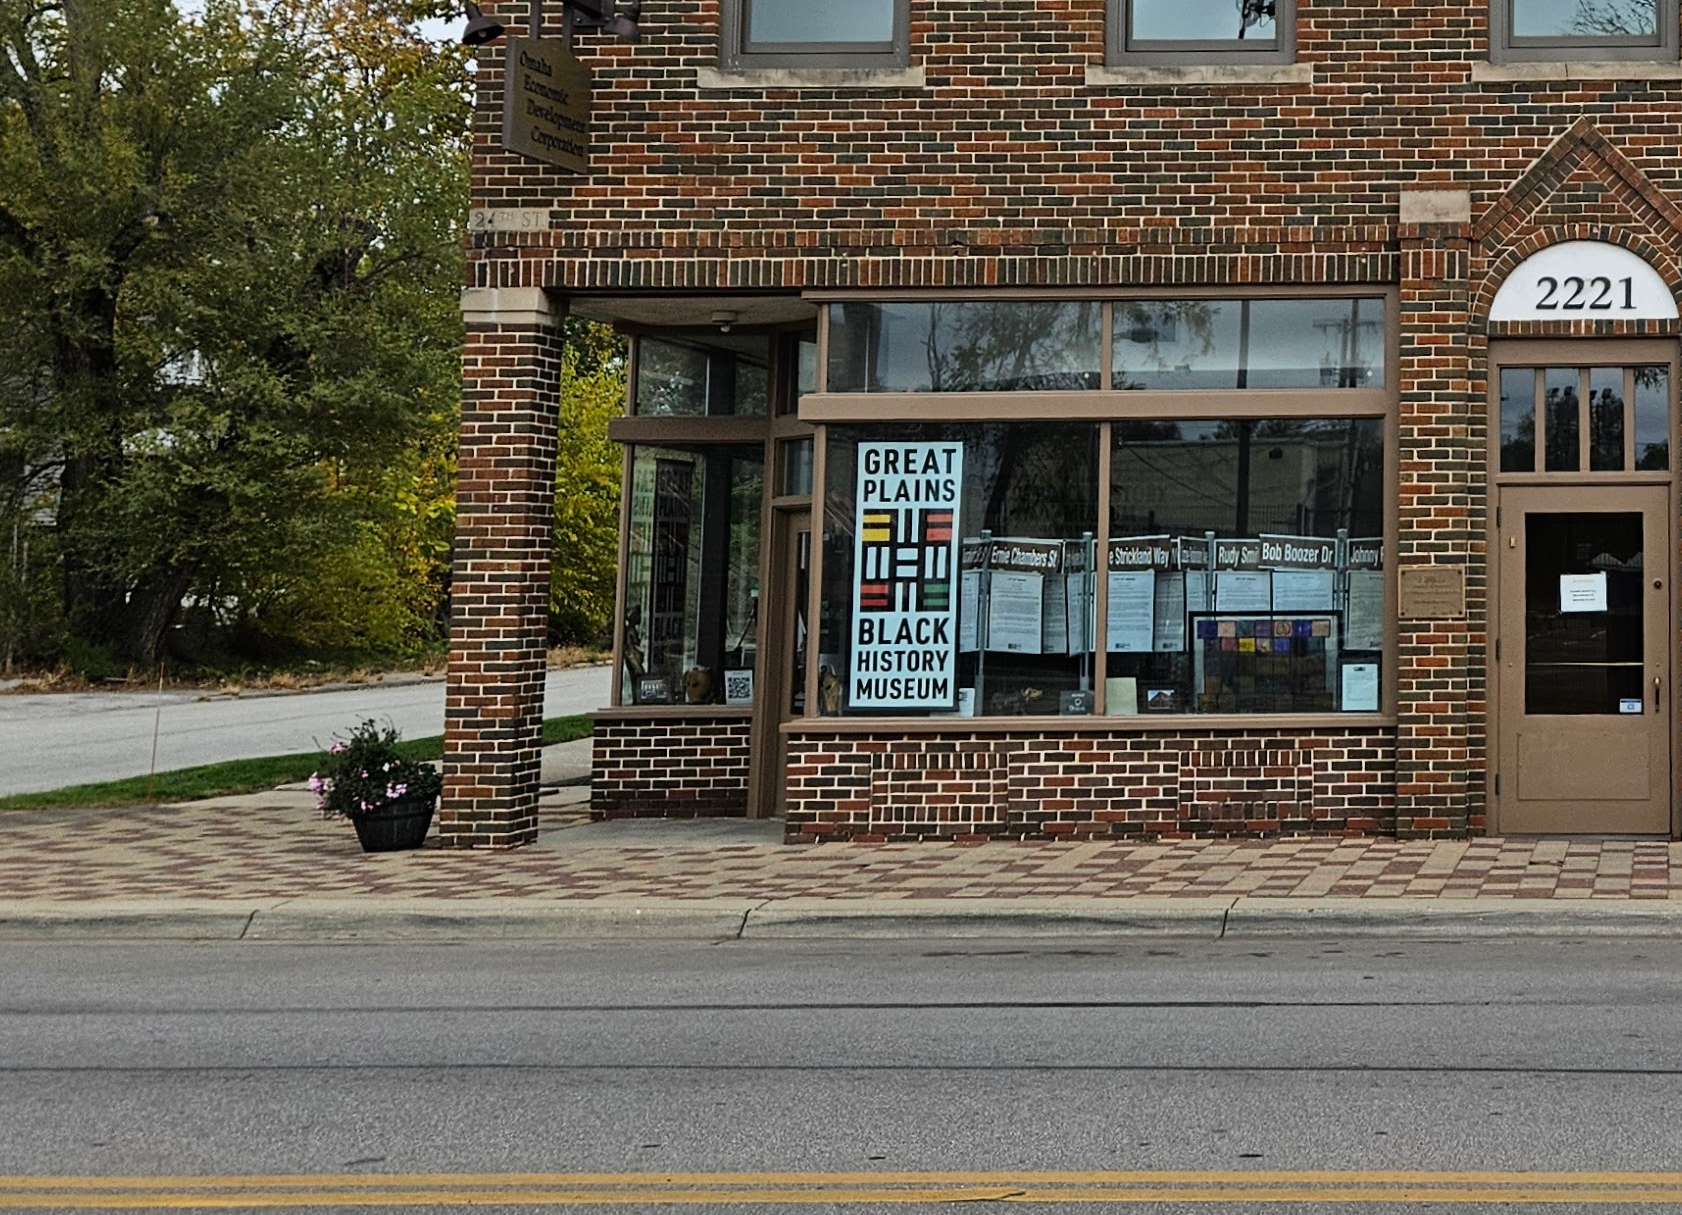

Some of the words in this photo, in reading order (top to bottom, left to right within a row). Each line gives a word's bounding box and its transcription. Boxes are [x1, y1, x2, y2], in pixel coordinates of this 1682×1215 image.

[520, 50, 552, 77] Omaha
[524, 73, 570, 105] Economic
[526, 97, 586, 134] Development
[530, 126, 584, 157] Corporation
[1535, 276, 1637, 310] 2221
[865, 448, 956, 475] GREAT
[863, 479, 955, 502] PLAINS
[1011, 547, 1048, 567] Chambers
[1115, 546, 1152, 565] Strickland
[1153, 546, 1170, 568] Way
[1218, 546, 1240, 567] Rudy
[1241, 546, 1260, 564] Smi
[1262, 542, 1281, 561] Bob
[1284, 543, 1319, 563] Boozer
[1321, 545, 1334, 564] Dr
[1351, 546, 1379, 567] Johnny
[858, 617, 949, 645] BLACK
[857, 650, 949, 672] HISTORY
[856, 678, 948, 699] MUSEUM
